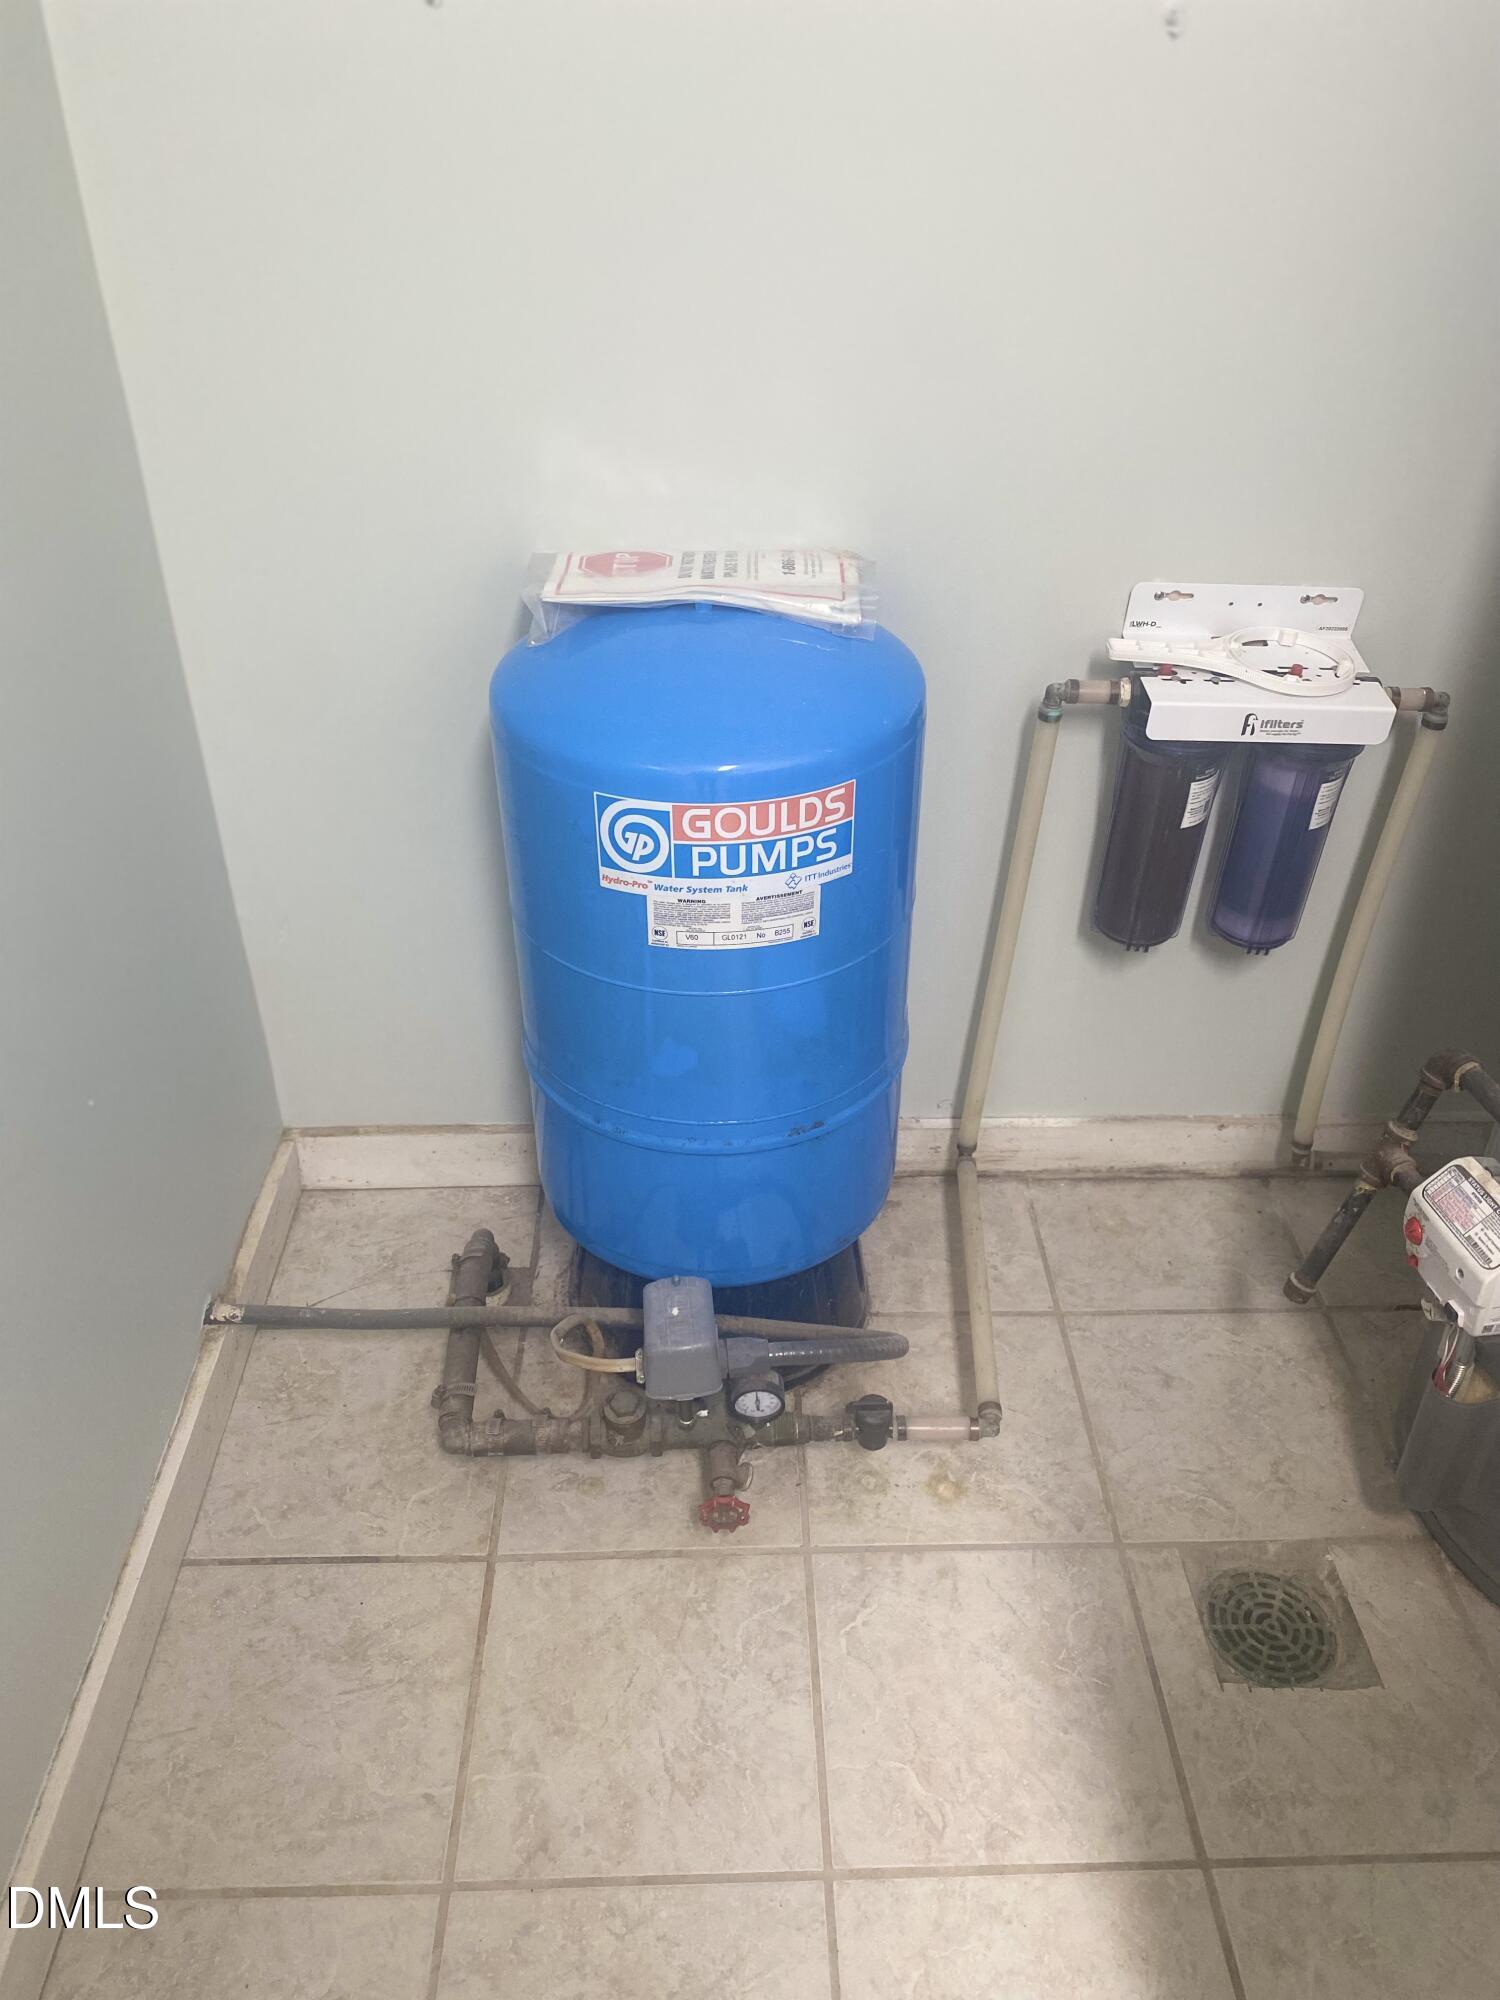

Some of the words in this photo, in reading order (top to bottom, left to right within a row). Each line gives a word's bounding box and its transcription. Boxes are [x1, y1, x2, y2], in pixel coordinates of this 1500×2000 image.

[681, 787, 846, 839] GOULDS
[691, 828, 838, 877] PUMPS
[804, 872, 817, 883] ITT
[817, 864, 851, 879] Industries
[653, 883, 684, 893] Water
[685, 885, 723, 895] System
[726, 884, 749, 894] Tank
[756, 889, 804, 902] AVERTISSEMENT
[803, 919, 815, 929] NSF
[654, 929, 667, 937] NSF
[1468, 1176, 1485, 1196] STATUS
[1483, 1193, 1498, 1210] LIGHT
